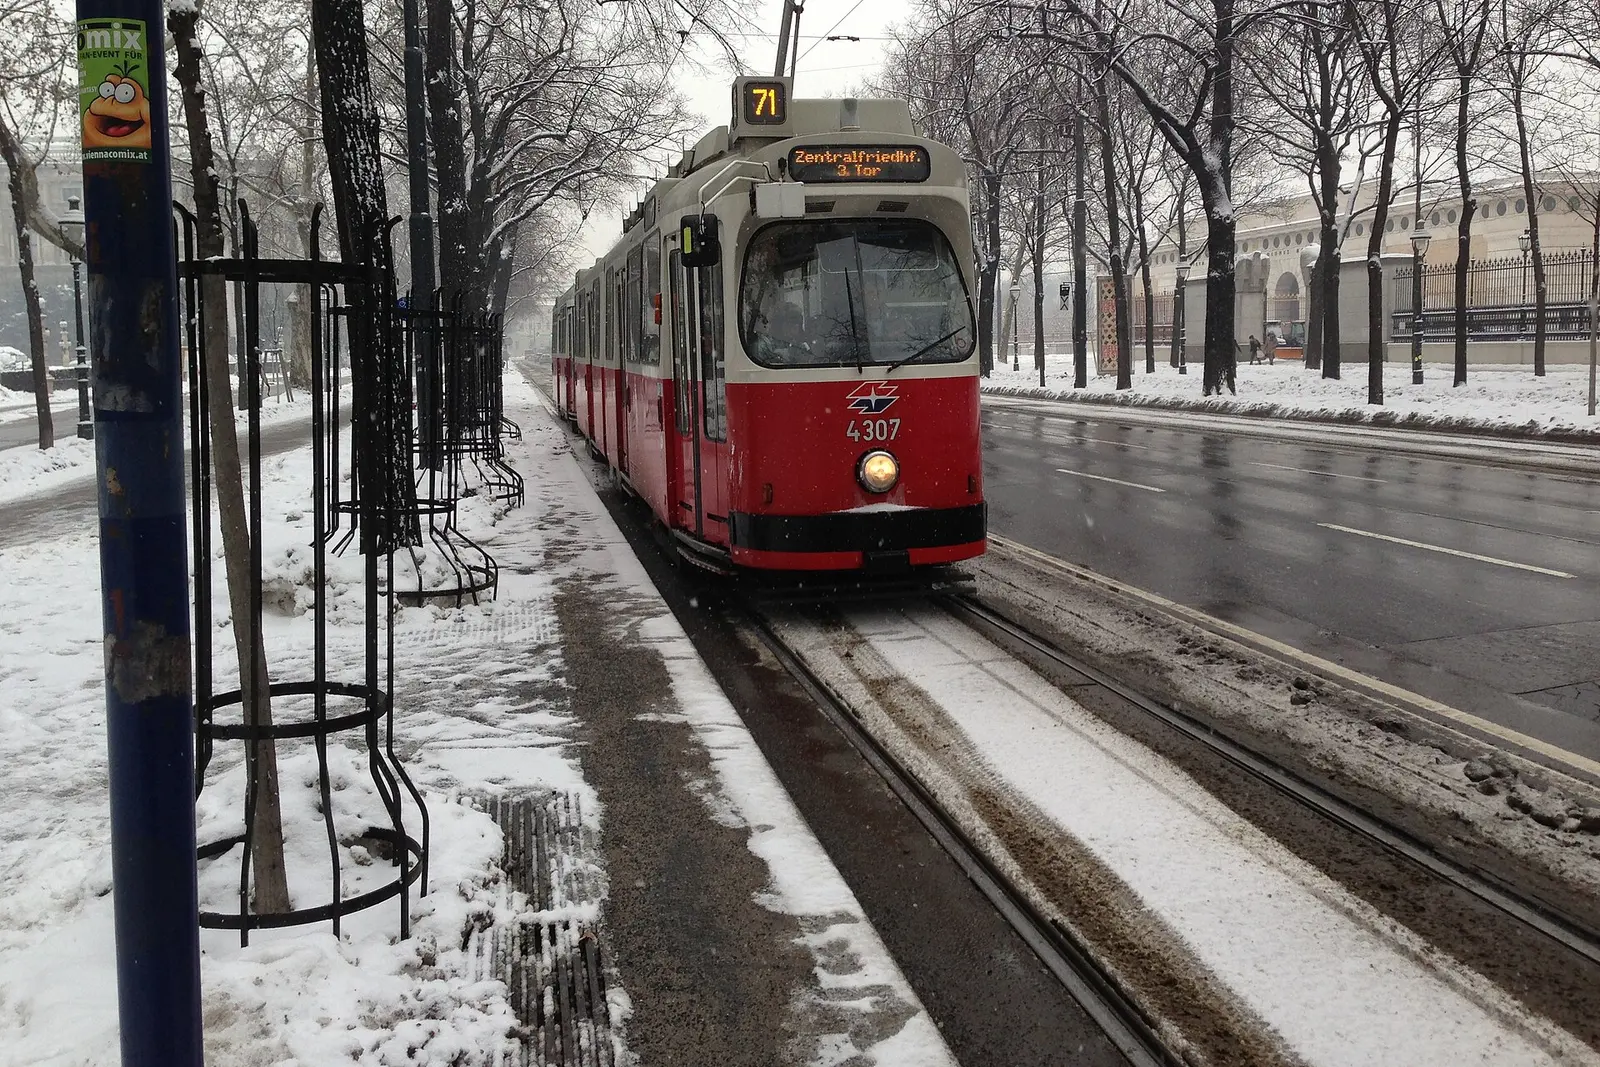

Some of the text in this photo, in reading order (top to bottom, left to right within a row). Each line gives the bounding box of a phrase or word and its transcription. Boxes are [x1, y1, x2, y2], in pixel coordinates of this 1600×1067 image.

[124, 50, 143, 60] FÜR
[752, 88, 776, 116] 71
[795, 150, 921, 163] Zentralfriedhf.
[855, 164, 881, 177] Tor
[846, 418, 901, 442] 4307
